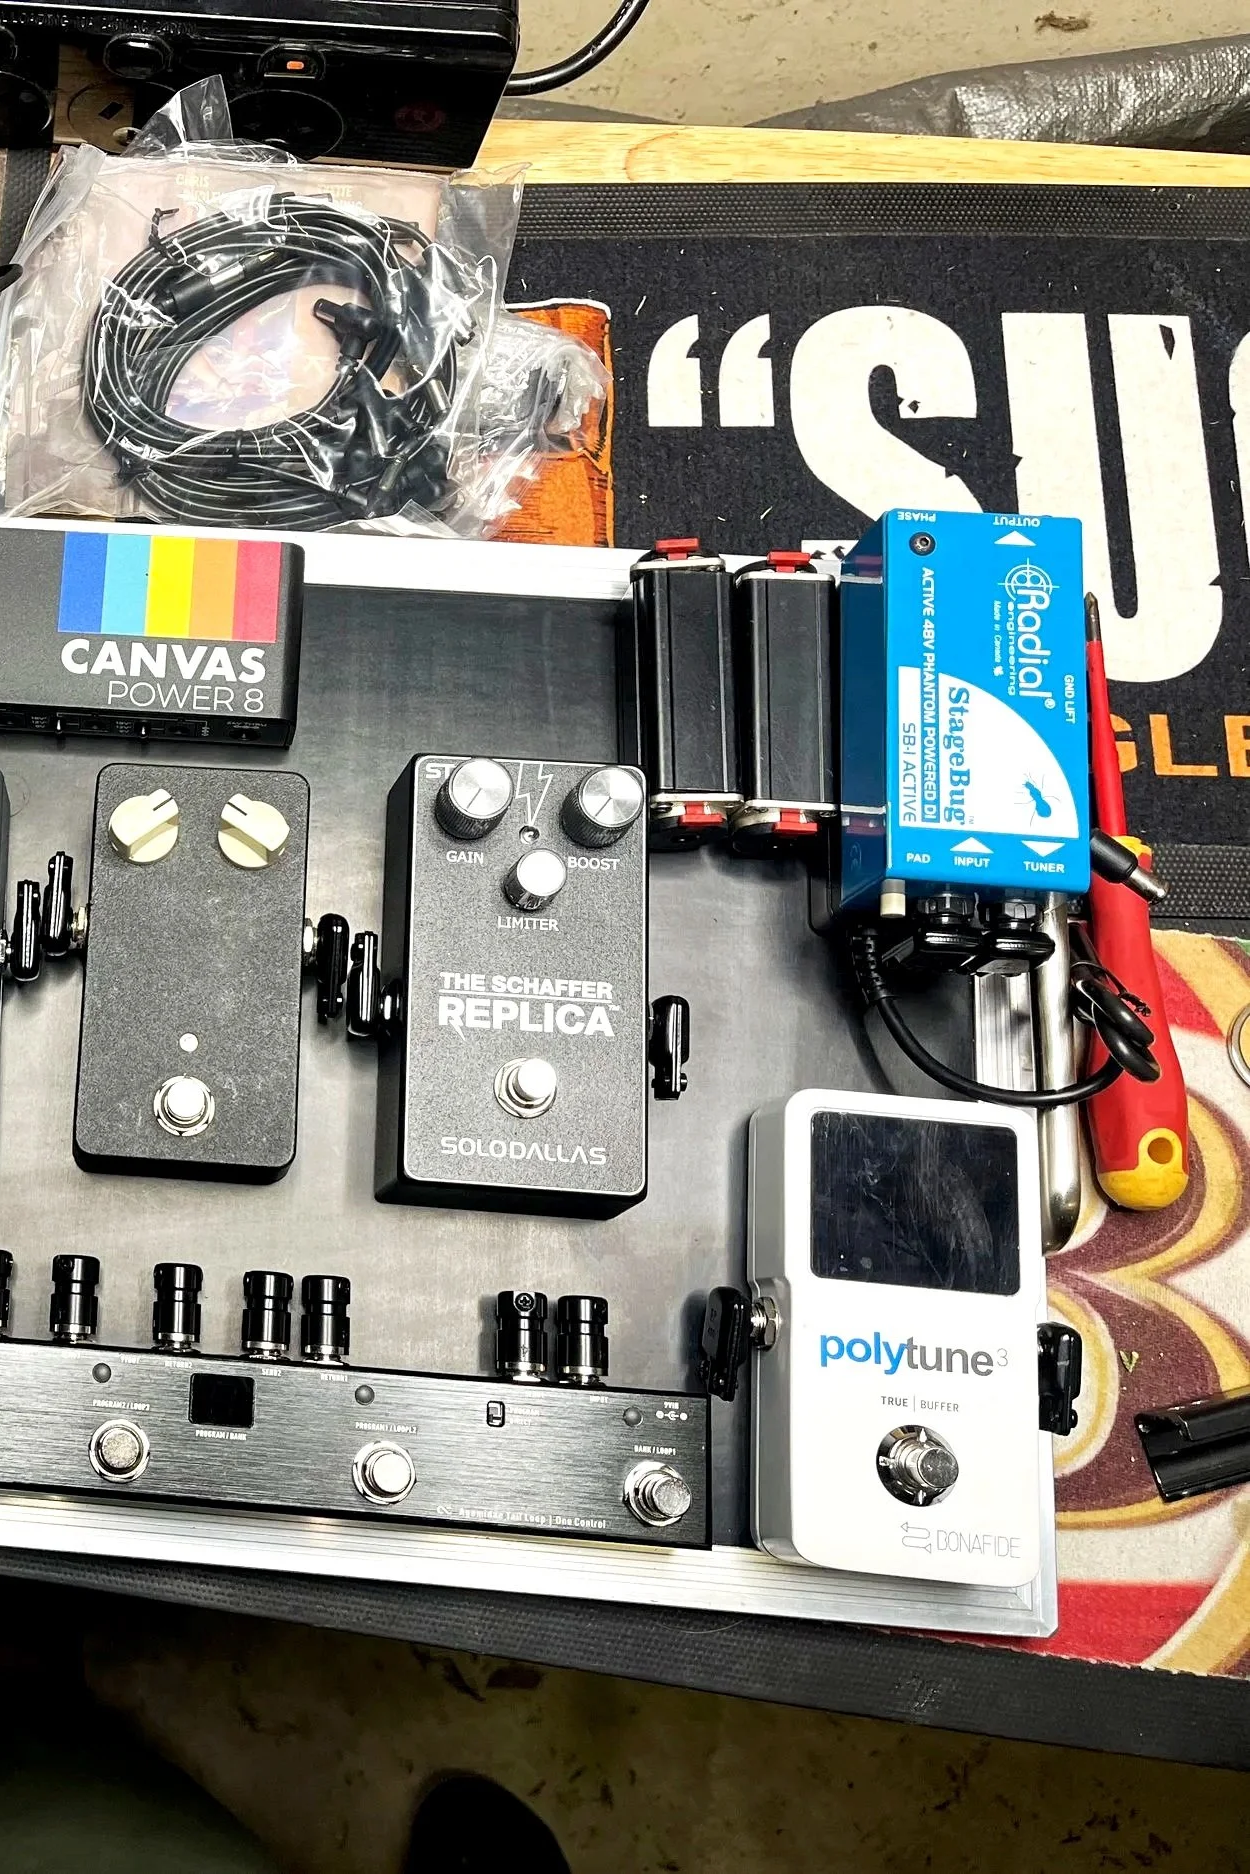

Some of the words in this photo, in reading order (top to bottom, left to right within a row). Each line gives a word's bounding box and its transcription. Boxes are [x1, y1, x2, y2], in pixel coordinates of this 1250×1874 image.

[648, 305, 1250, 683] “SU
[897, 511, 936, 522] PHASE
[992, 515, 1040, 528] OUTPUT
[922, 567, 935, 617] ACTIVE
[922, 619, 935, 650] 48V
[994, 623, 1001, 631] in
[994, 634, 1002, 663] Canada
[1007, 601, 1017, 696] engineering
[61, 638, 267, 685] CANVAS
[106, 680, 235, 712] POWER
[243, 684, 265, 714] 8
[923, 652, 936, 724] PHANTOM
[1064, 674, 1075, 699] GND
[1065, 701, 1076, 724] LIFT
[923, 727, 937, 802] POWERED
[903, 760, 917, 822] ACTIVE
[924, 804, 937, 819] DI
[445, 850, 485, 865] GAIN
[567, 856, 620, 871] BOOST
[906, 851, 931, 864] PAD
[953, 855, 990, 869] INPUT
[1023, 860, 1065, 874] TUNER
[497, 916, 559, 932] LIMITER
[439, 971, 488, 993] THE
[490, 974, 614, 1000] SCHAFFER
[440, 1136, 607, 1166] SOLODALLAS
[881, 1395, 909, 1407] TRUE
[920, 1400, 959, 1412] BUFFER
[574, 1517, 607, 1529] Control
[936, 1529, 1021, 1560] BONAFIDE
